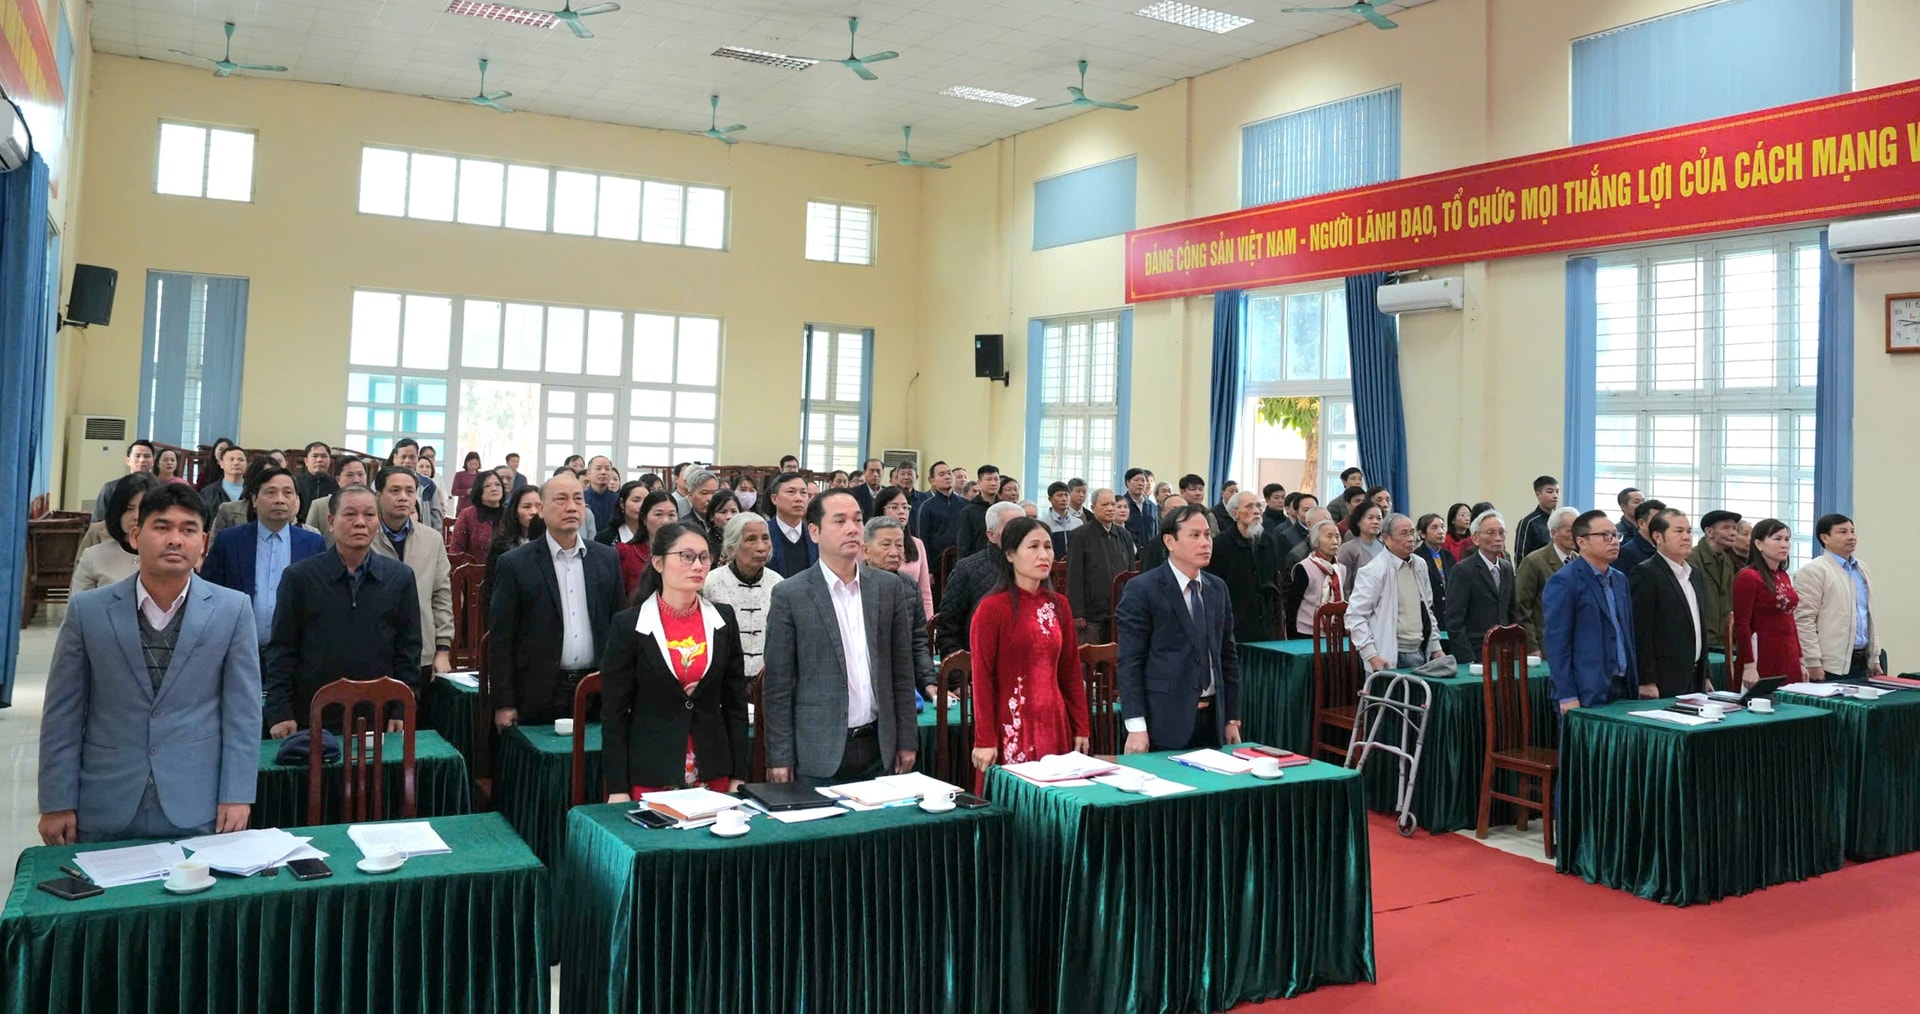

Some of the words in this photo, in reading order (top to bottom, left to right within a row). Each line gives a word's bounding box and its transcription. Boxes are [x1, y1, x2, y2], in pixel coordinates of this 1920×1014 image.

[1145, 243, 1174, 276] ĐẢNG
[1176, 240, 1207, 275] CỘNG
[1210, 231, 1234, 266] SẢN
[1237, 229, 1263, 267] VIỆT
[1266, 227, 1297, 258] NAM
[1309, 212, 1353, 251] NGƯỜI
[1357, 209, 1397, 245] LÃNH
[1401, 204, 1437, 243] ĐẠO,
[1442, 187, 1464, 232] TỔ
[1467, 187, 1515, 229] CHỨC
[1521, 183, 1558, 225] MỌI
[1563, 163, 1632, 214] THẮNG
[1638, 161, 1672, 209] LỢI
[1679, 146, 1727, 198] CỦA
[1734, 140, 1803, 189] CÁCH
[1812, 126, 1898, 182] MẠNG
